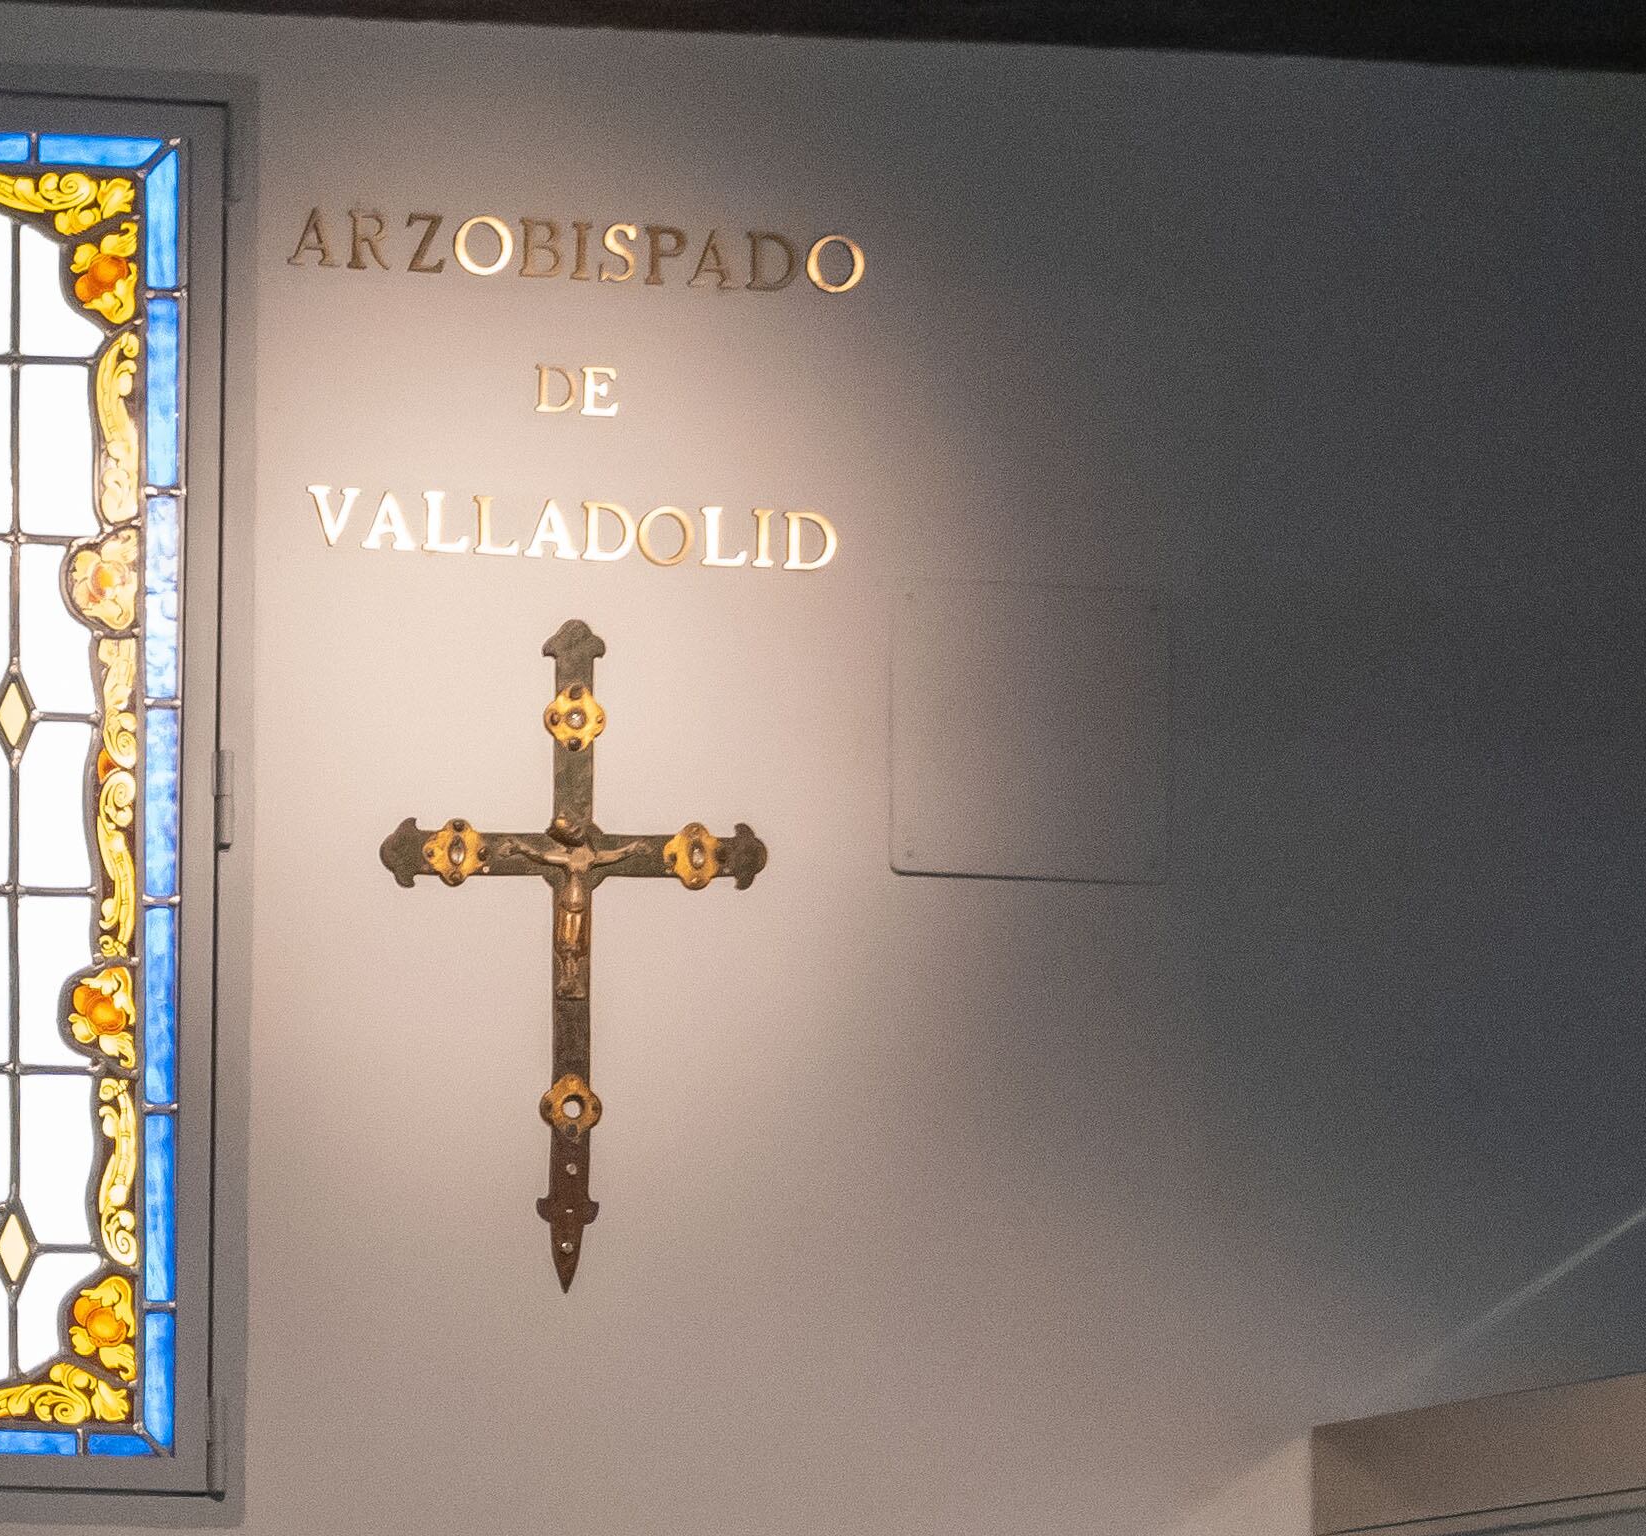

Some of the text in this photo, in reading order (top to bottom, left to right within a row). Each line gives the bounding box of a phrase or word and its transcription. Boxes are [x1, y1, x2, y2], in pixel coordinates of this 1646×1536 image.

[287, 207, 865, 293] ARZOBISPADO
[535, 364, 619, 418] DE
[308, 484, 838, 571] VALLADOLID
